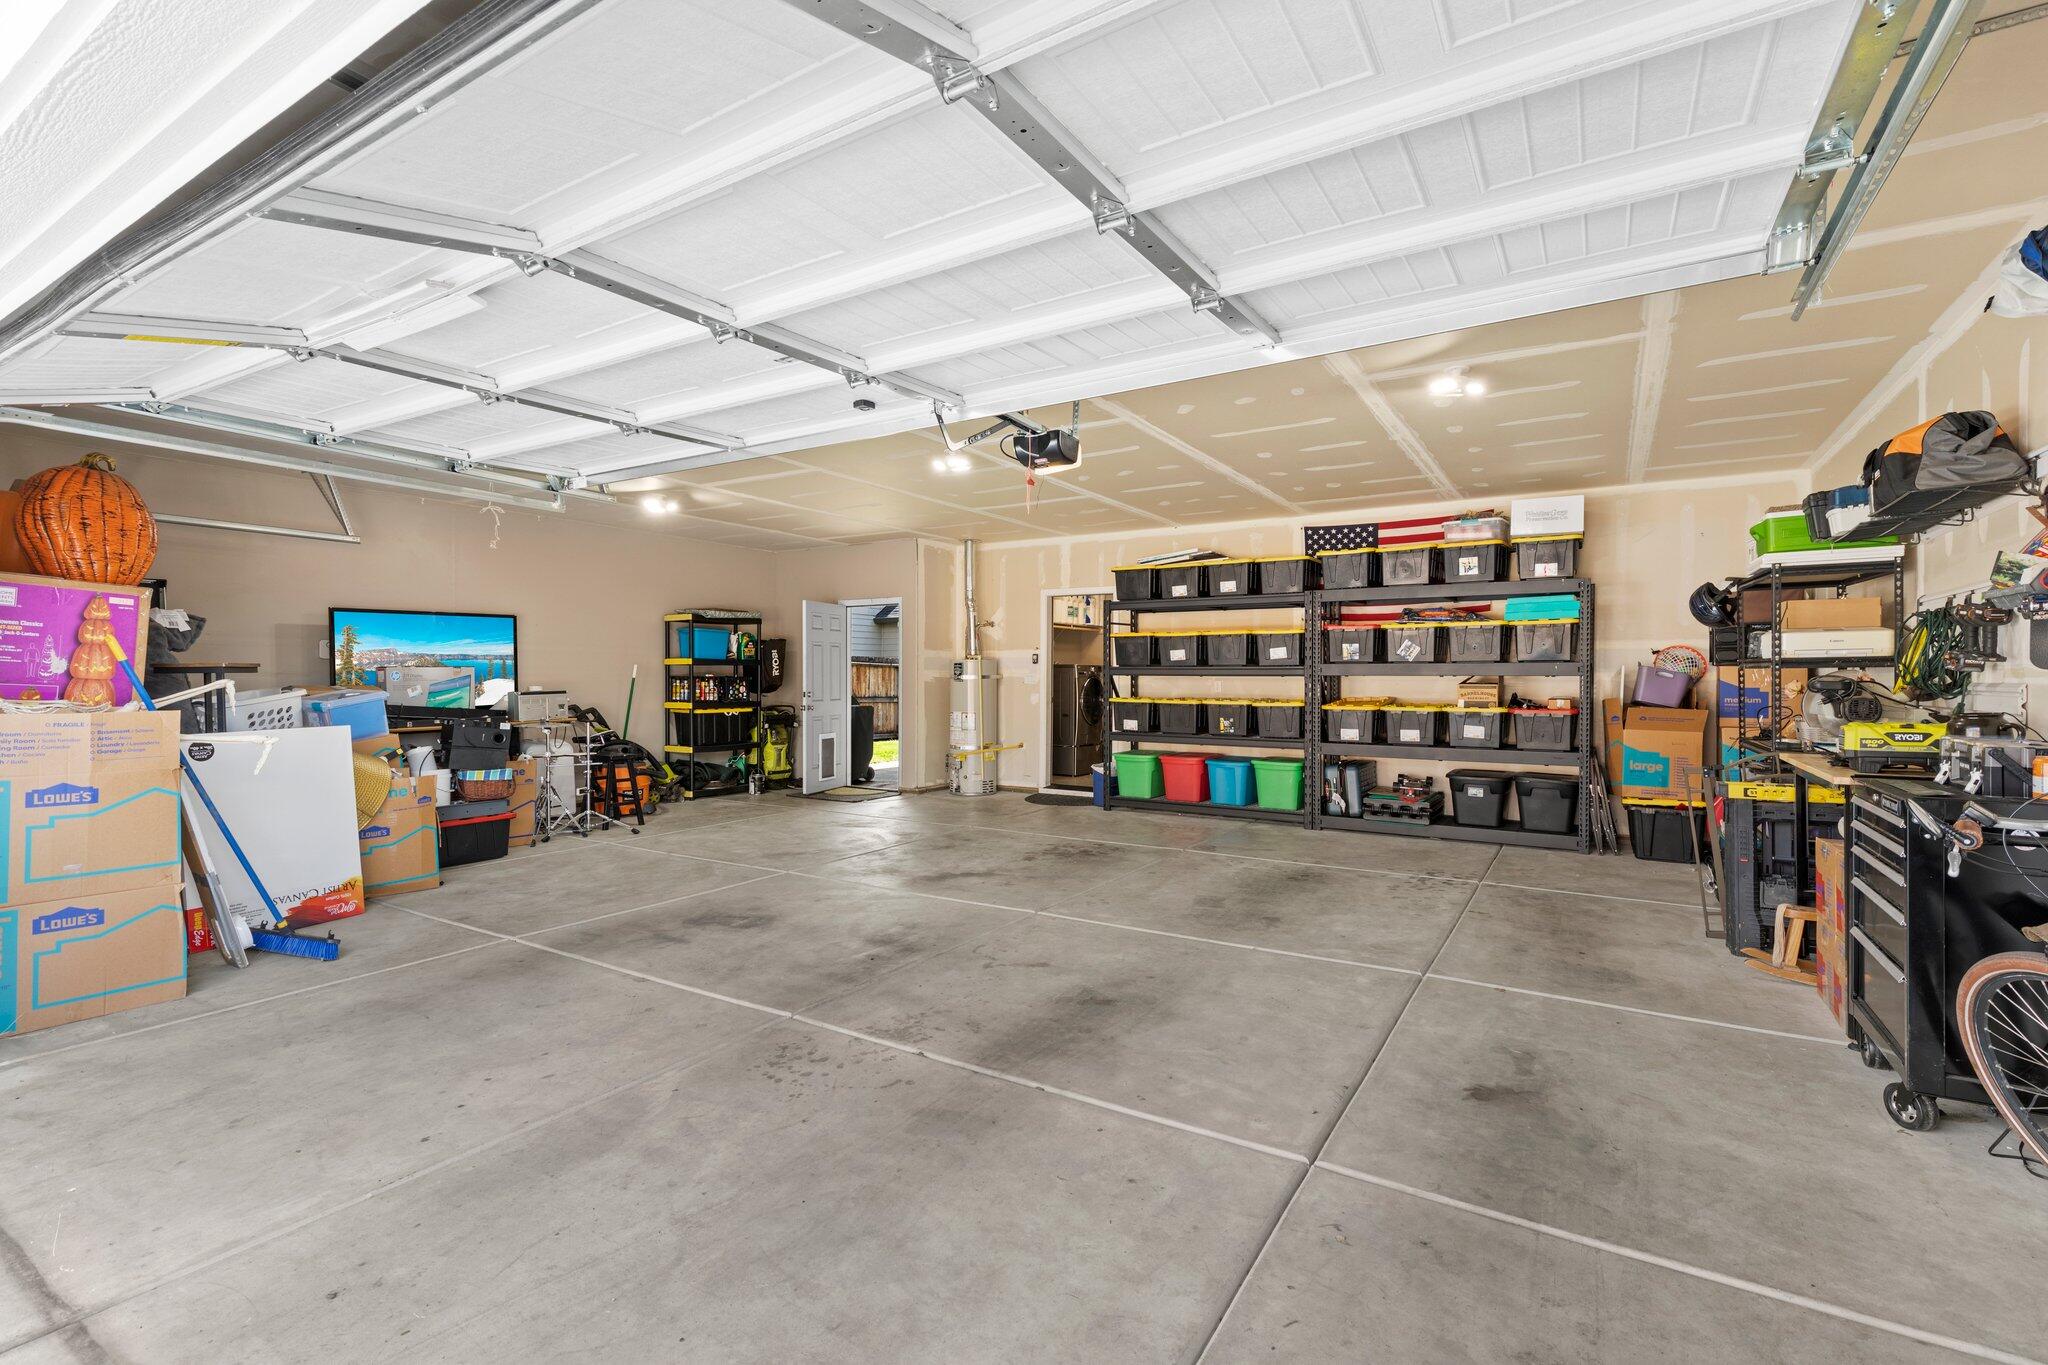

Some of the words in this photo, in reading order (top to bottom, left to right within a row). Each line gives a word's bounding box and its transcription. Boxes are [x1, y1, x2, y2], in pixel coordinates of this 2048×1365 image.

[20, 620, 43, 628] Classics
[771, 649, 780, 676] RYOBI
[1894, 733, 1923, 741] RYOBI
[1629, 760, 1664, 772] large
[33, 790, 92, 805] LOWE'S
[361, 829, 388, 839] LOWE'S
[321, 879, 358, 896] ARTIST
[272, 887, 319, 905] CANVAS
[40, 913, 98, 931] LOWE'S
[192, 930, 205, 946] Edge
